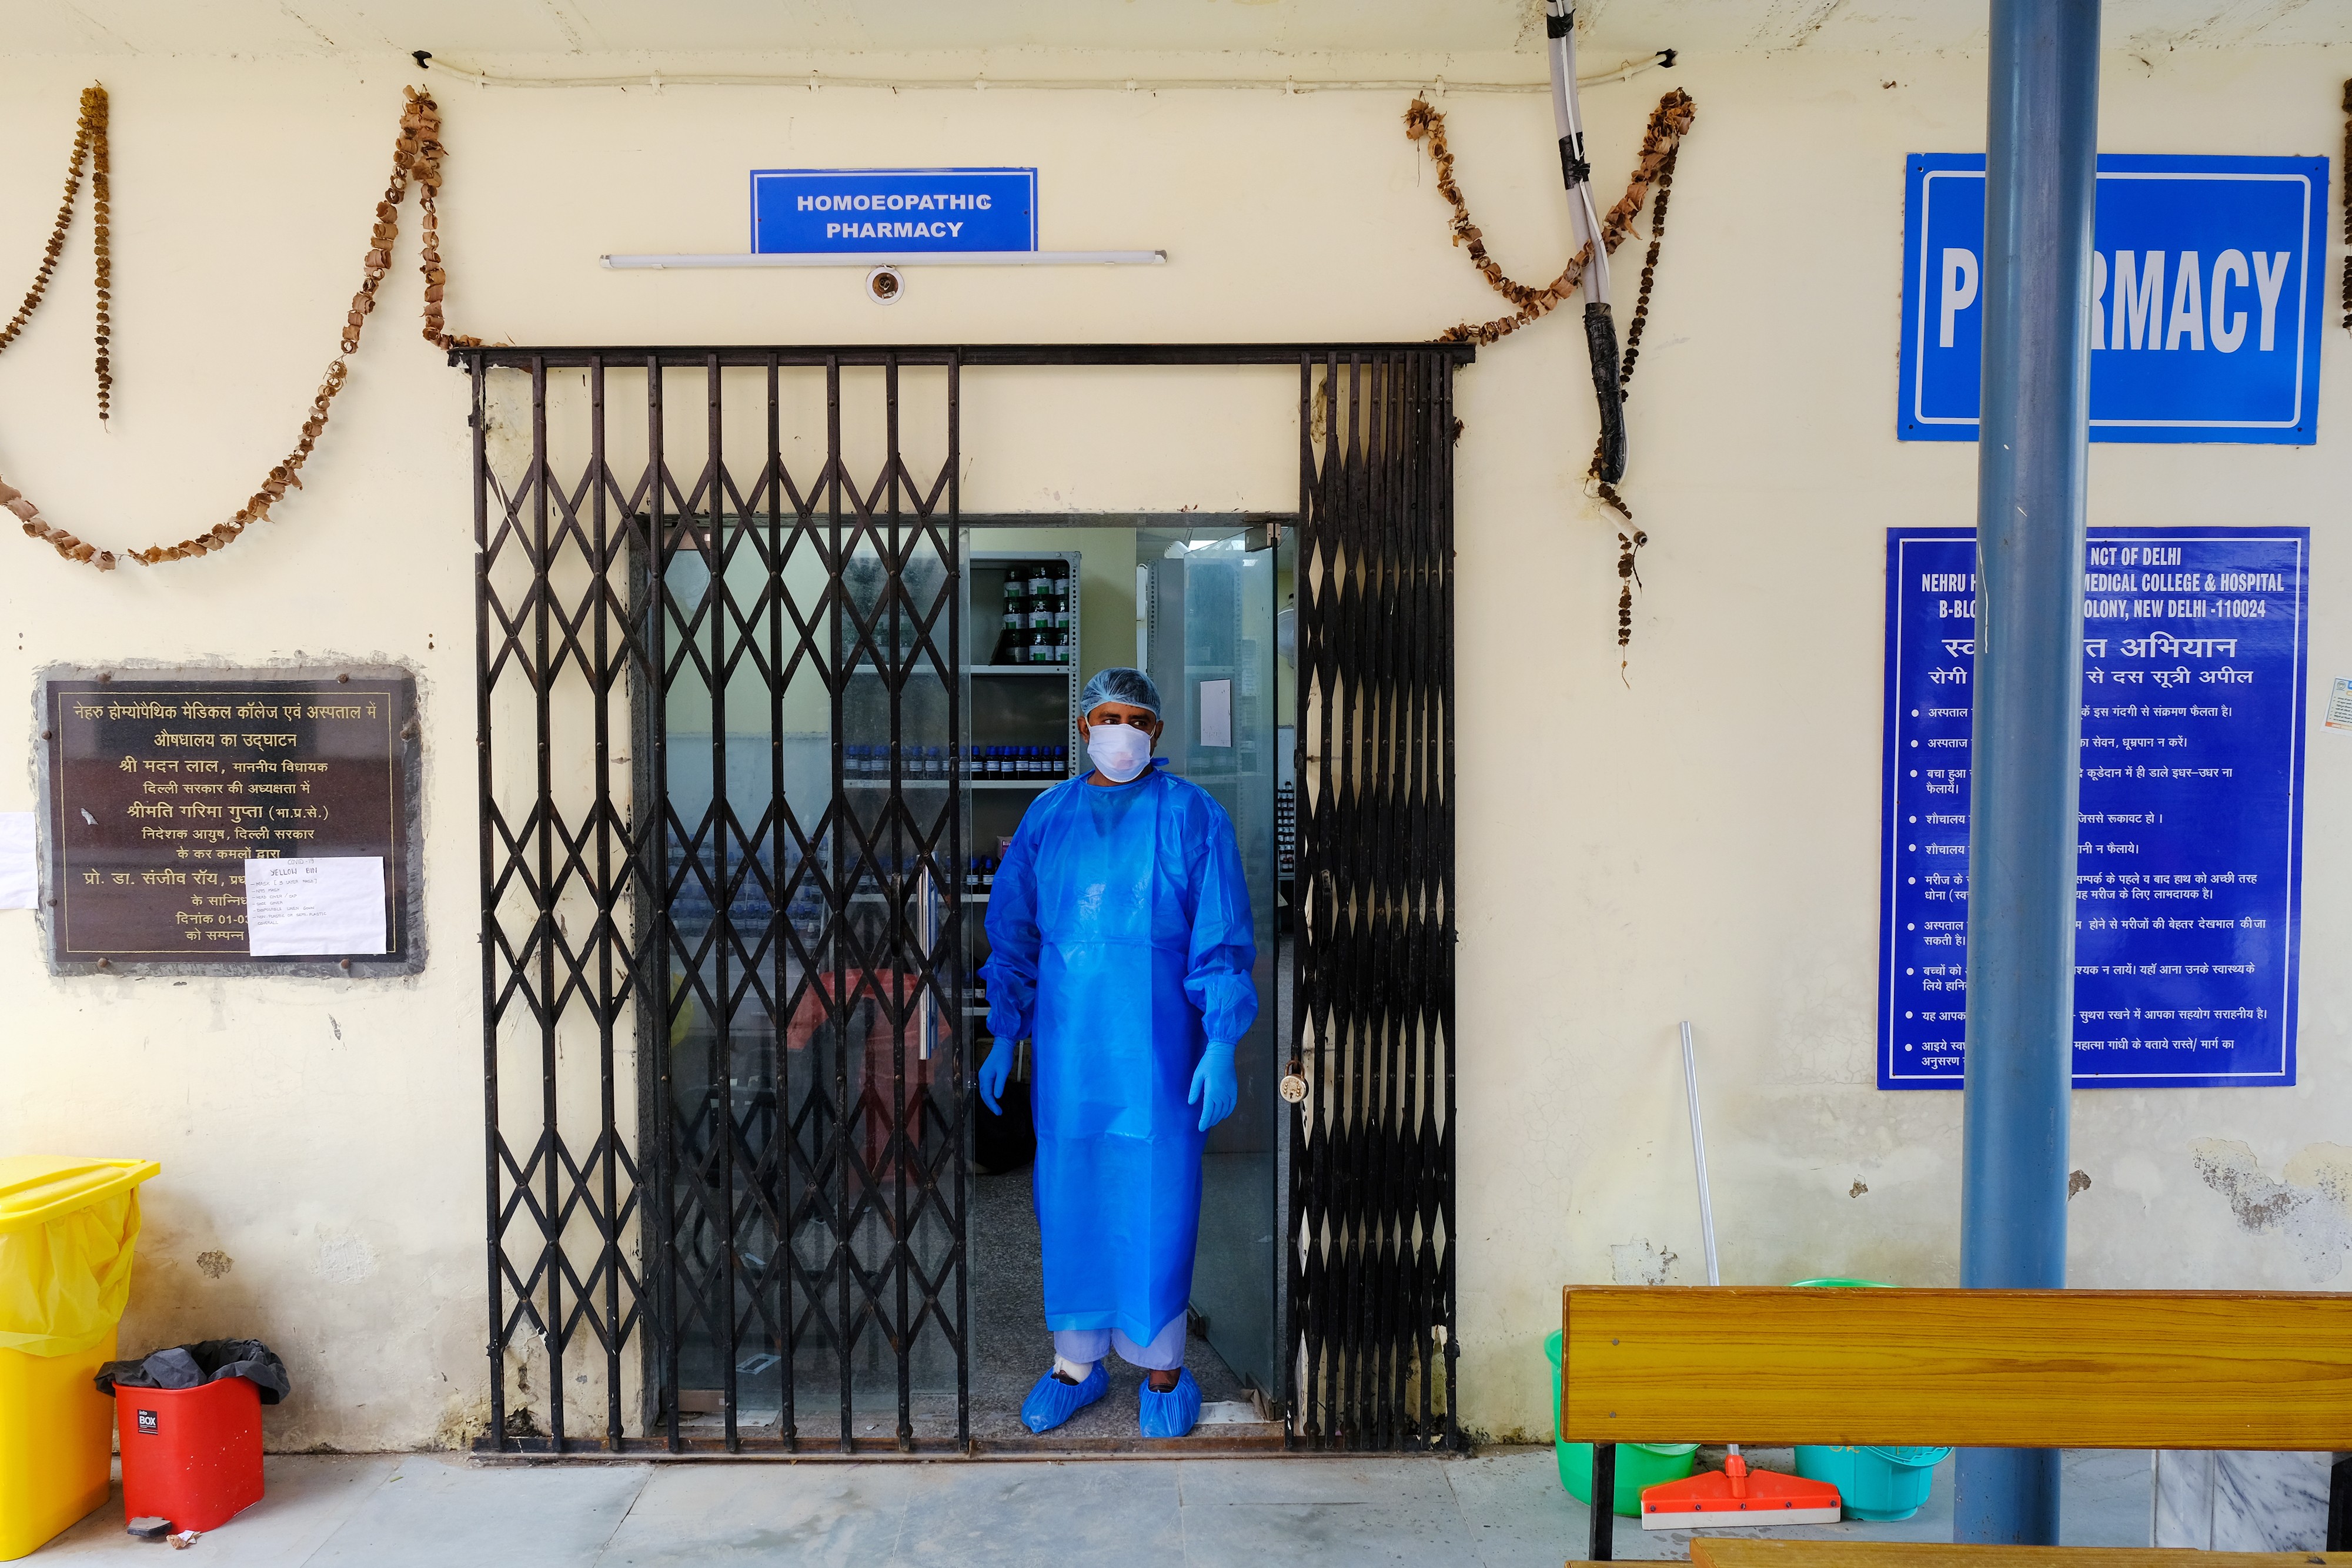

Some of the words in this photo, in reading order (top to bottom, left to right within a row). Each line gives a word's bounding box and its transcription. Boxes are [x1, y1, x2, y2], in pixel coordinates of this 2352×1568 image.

[797, 195, 991, 211] HOMOEOPATHIC
[827, 222, 963, 238] PHARMACY
[2091, 547, 2117, 566] NCT
[2122, 547, 2139, 565] OF
[2143, 547, 2181, 565] DELHI
[1922, 574, 1966, 591] NEHRU
[2142, 574, 2200, 591] COLLEGE
[2204, 574, 2216, 591] &
[2221, 573, 2284, 591] HOSPITAL
[2134, 600, 2163, 617] NEW
[2168, 600, 2206, 617] DELHI
[2120, 631, 2237, 657] अभियान
[1928, 667, 1967, 684] रोगी
[2086, 667, 2104, 683] से
[2111, 671, 2144, 683] दस
[2151, 666, 2191, 688] सूत्री
[2199, 666, 2253, 683] अपील
[72, 701, 103, 720] नेहरु
[108, 701, 177, 720] होम्योपैथिक
[181, 701, 231, 719] मेडिकल
[236, 701, 278, 719] कॉलेज
[282, 703, 301, 721] एवं
[307, 706, 361, 718] अस्पताल
[366, 701, 376, 718] में
[154, 731, 215, 747] औषधालय
[219, 734, 237, 747] का
[119, 757, 137, 773] श्री
[143, 761, 179, 773] मदन
[184, 761, 225, 774] लाल,
[232, 760, 277, 772] माननीय
[281, 760, 328, 772] विधायक
[143, 781, 178, 794] दिल्ली
[182, 784, 223, 794] सरकार
[227, 781, 243, 793] की
[248, 784, 296, 793] अध्यक्षता
[300, 781, 310, 793] में
[127, 803, 173, 818] श्रीमति
[179, 803, 222, 817] गरिमा
[228, 807, 263, 823] गुप्ता
[142, 827, 188, 840] निदेशक
[192, 830, 230, 842] आयुष,
[234, 827, 269, 840] दिल्ली
[274, 830, 315, 839] सरकार
[176, 847, 189, 858] के
[192, 850, 212, 858] कर
[215, 847, 251, 859] कमलों
[82, 869, 104, 884] प्रो.
[111, 873, 135, 884] डा.
[141, 868, 186, 884] संजीव
[192, 870, 224, 887] रॉय,
[191, 894, 203, 906] के
[175, 912, 213, 924] दिनांक
[185, 929, 201, 940] को
[205, 931, 244, 940] सम्पन्न
[2074, 1041, 2104, 1051] महात्मा
[139, 1416, 156, 1426] BOX
